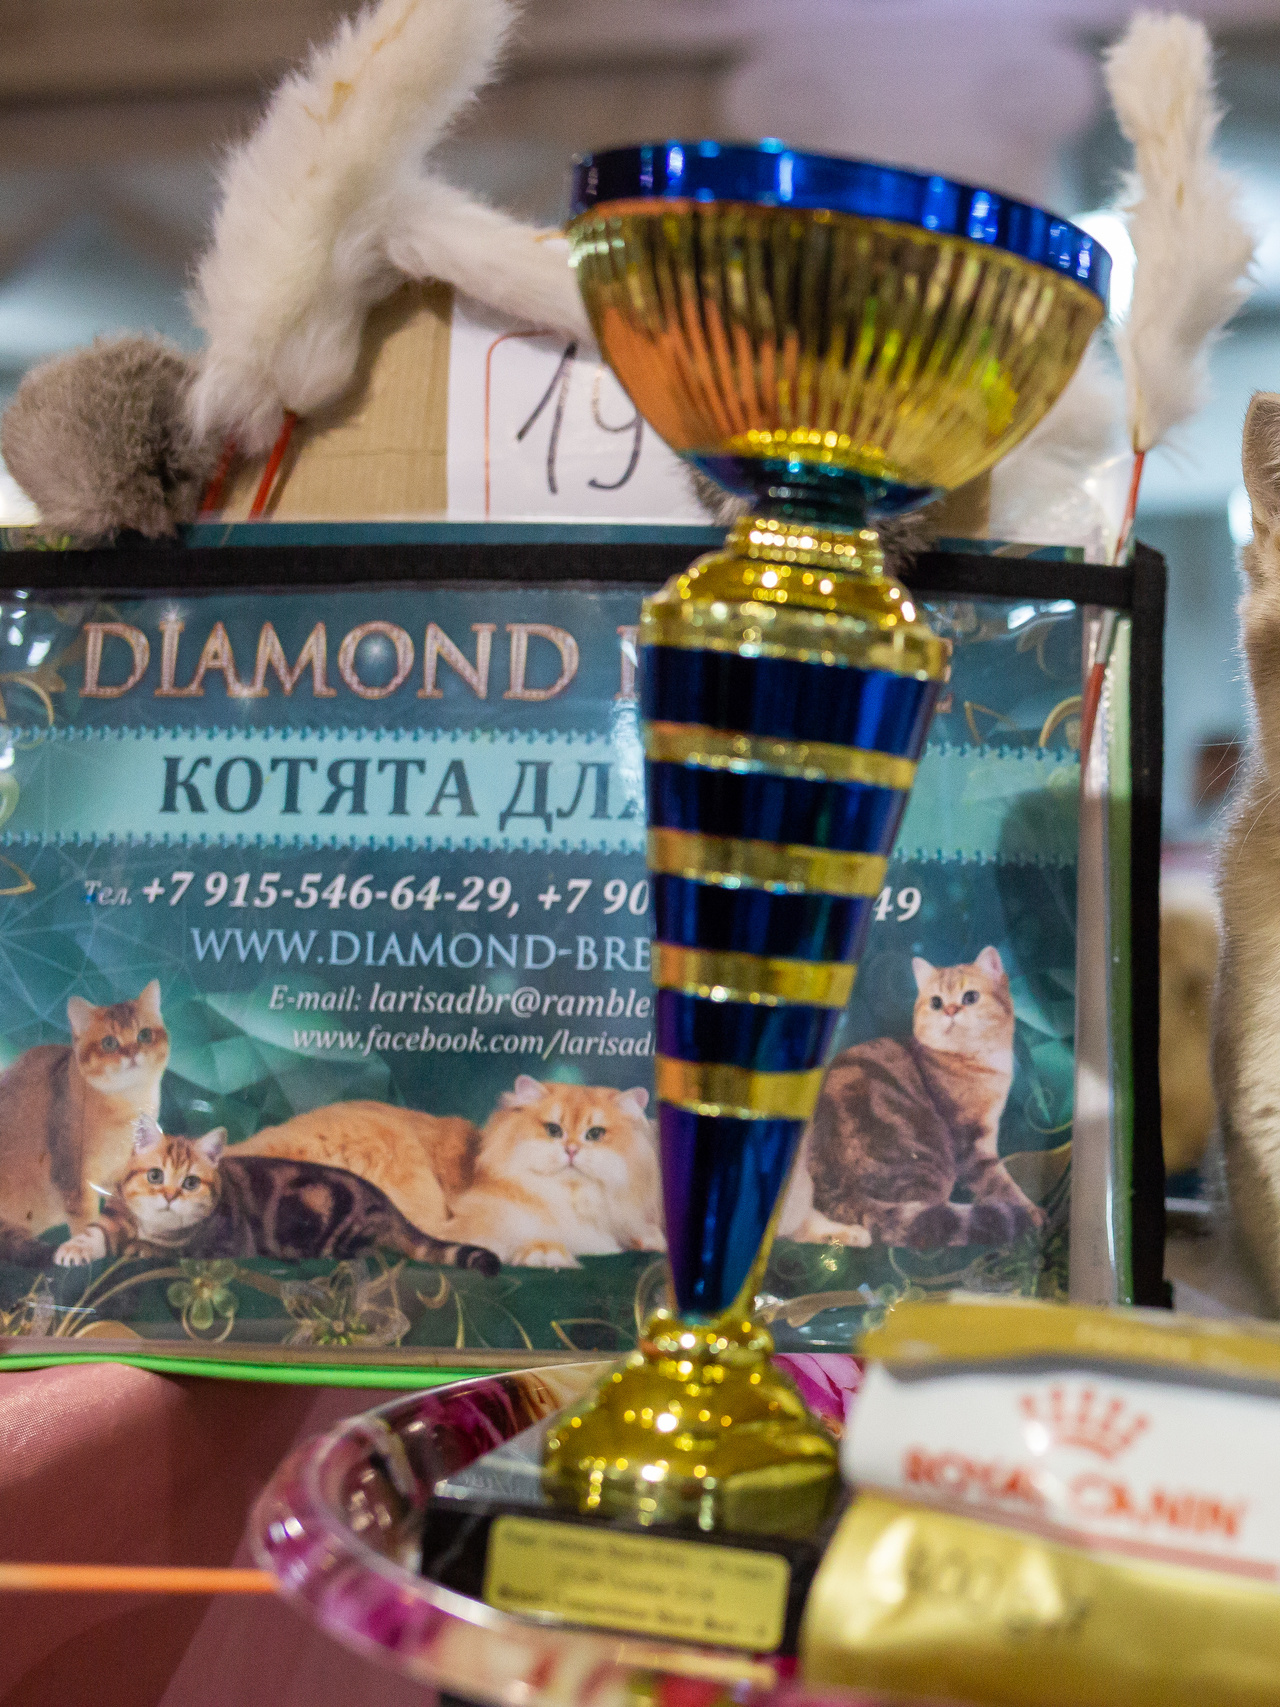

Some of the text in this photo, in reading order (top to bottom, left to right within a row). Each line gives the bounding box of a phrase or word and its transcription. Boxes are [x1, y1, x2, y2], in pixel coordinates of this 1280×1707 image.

[516, 339, 644, 492] 19
[79, 620, 580, 700] DIAMOND
[159, 755, 480, 818] КОТЯТА
[142, 870, 195, 908] +7
[203, 870, 520, 919] 915-546-64-29,
[537, 877, 593, 915] +7
[268, 981, 656, 1019] E-mail: larisadbr@ramble
[292, 1023, 657, 1061] www.facebook.com/larisad
